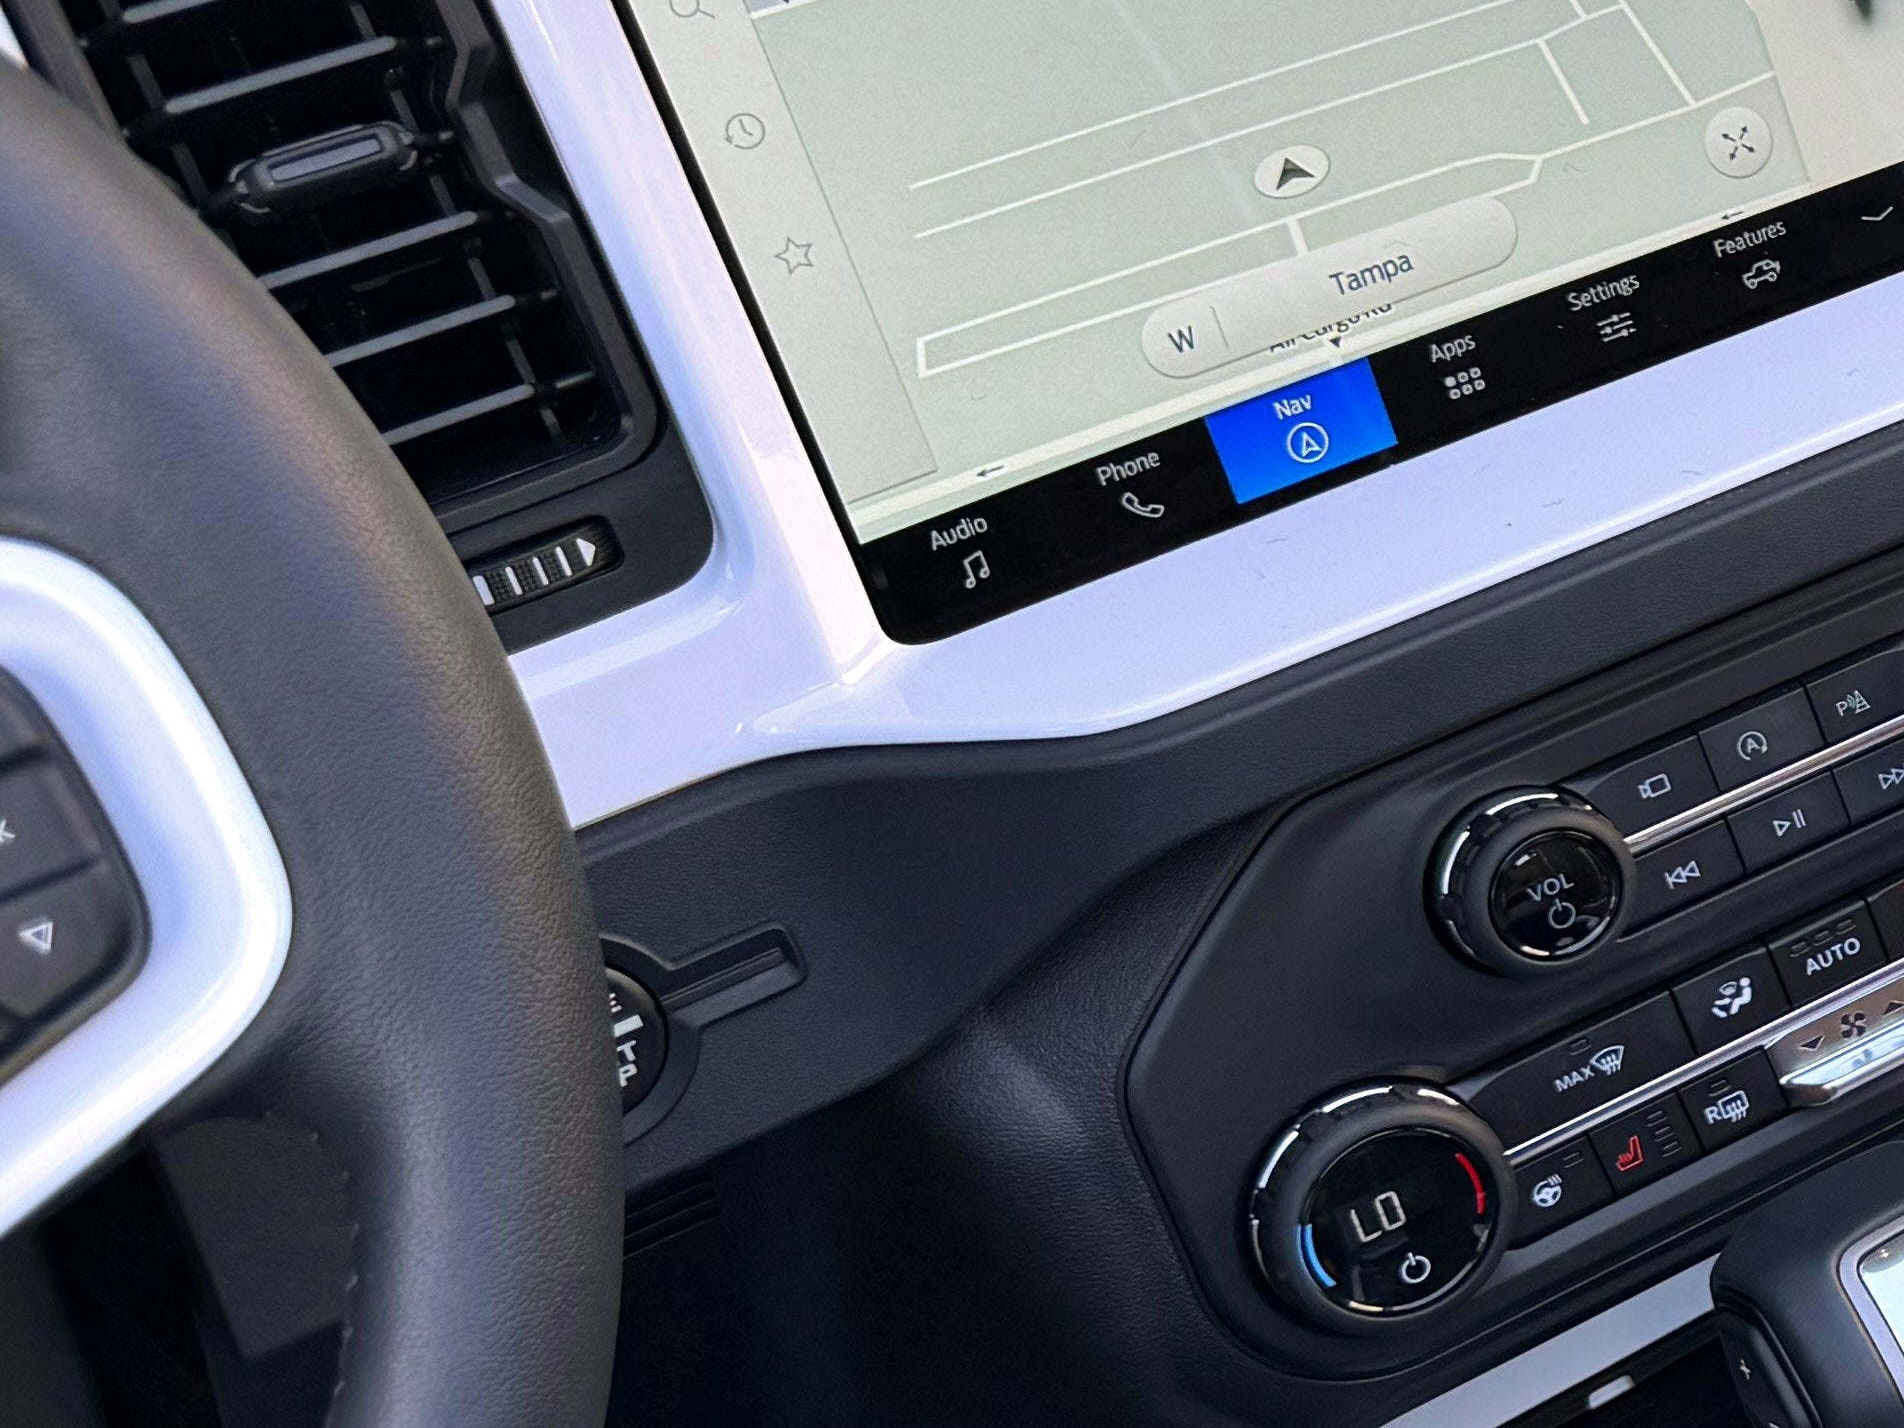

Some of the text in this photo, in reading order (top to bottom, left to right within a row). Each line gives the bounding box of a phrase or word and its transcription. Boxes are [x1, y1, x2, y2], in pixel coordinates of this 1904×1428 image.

[1713, 219, 1787, 258] Features
[1169, 252, 1414, 354] W Tampa
[1567, 273, 1640, 313] Settings
[1429, 331, 1476, 364] Apps
[1273, 391, 1313, 420] Nav
[1097, 448, 1161, 487] Phone
[930, 513, 988, 551] Audio
[1526, 874, 1573, 904] VOL
[1804, 936, 1861, 975] AUTO
[1554, 1064, 1594, 1093] MAX
[1350, 1190, 1405, 1243] LO
